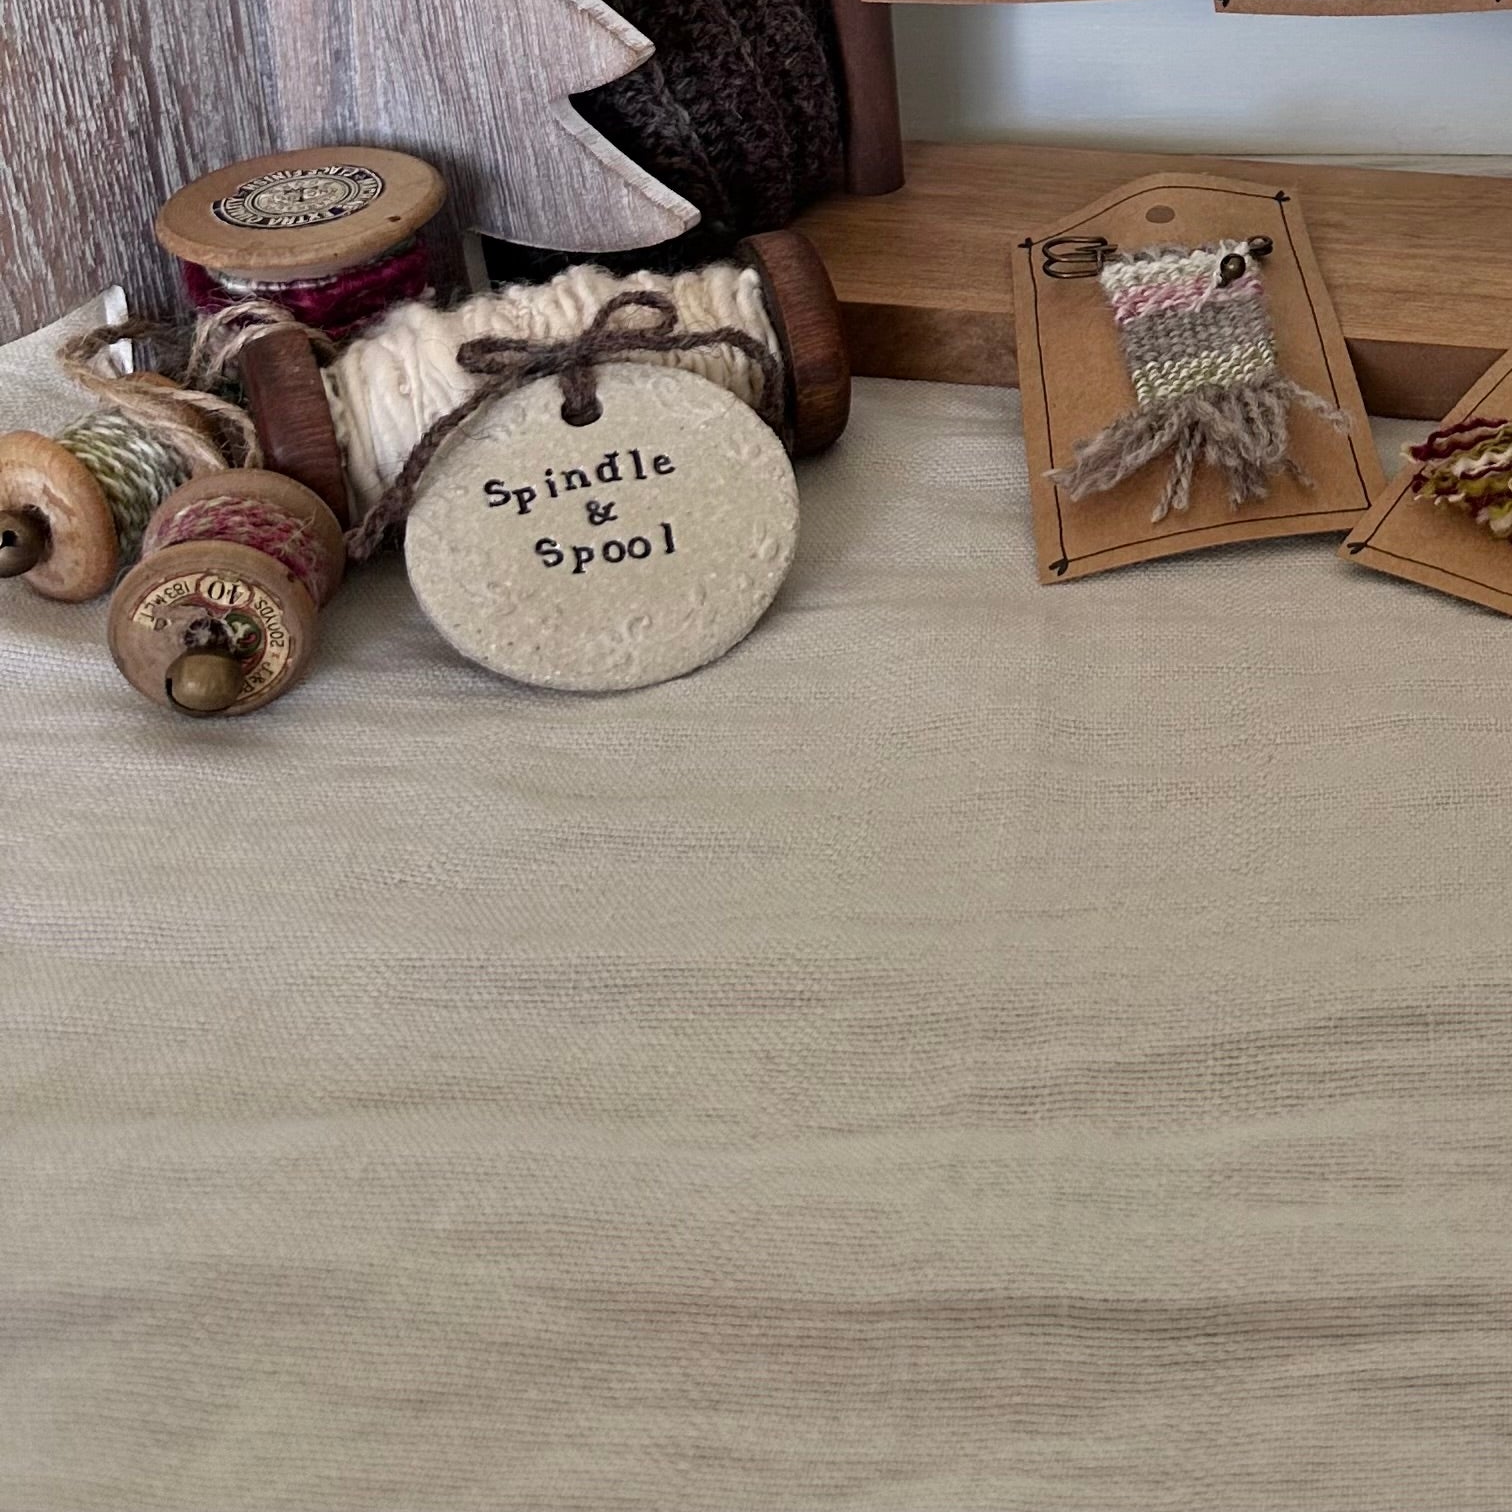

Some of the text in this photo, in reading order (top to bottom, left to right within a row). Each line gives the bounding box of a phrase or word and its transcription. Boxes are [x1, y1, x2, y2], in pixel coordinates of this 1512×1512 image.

[483, 447, 677, 515] Spindle
[585, 499, 619, 526] &
[534, 521, 677, 575] Spool
[163, 580, 190, 600] 183
[207, 580, 244, 605] 40
